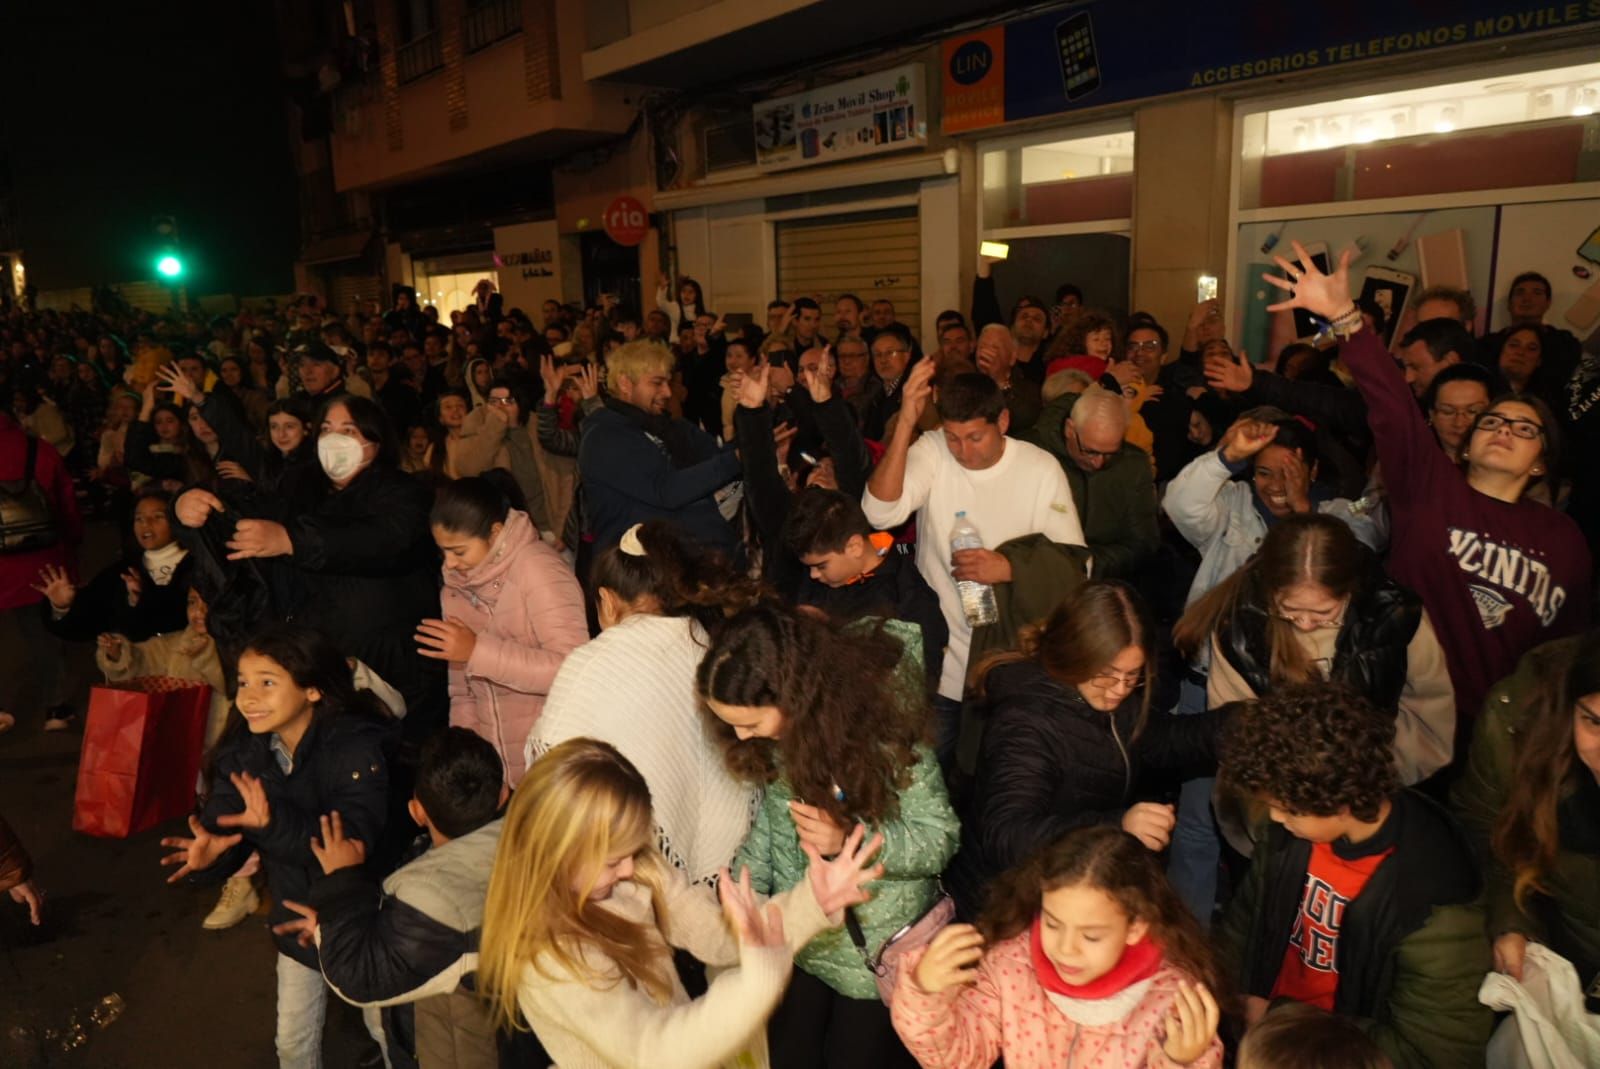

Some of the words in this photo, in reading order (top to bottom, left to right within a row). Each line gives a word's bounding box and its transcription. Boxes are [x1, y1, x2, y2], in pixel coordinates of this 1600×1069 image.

[1191, 49, 1319, 87] ACCESORIOS
[1325, 22, 1467, 63] TELEFONOS
[1473, 0, 1600, 37] MOVILES
[956, 50, 988, 75] LIN
[868, 87, 896, 103] Shop
[611, 201, 645, 228] ria
